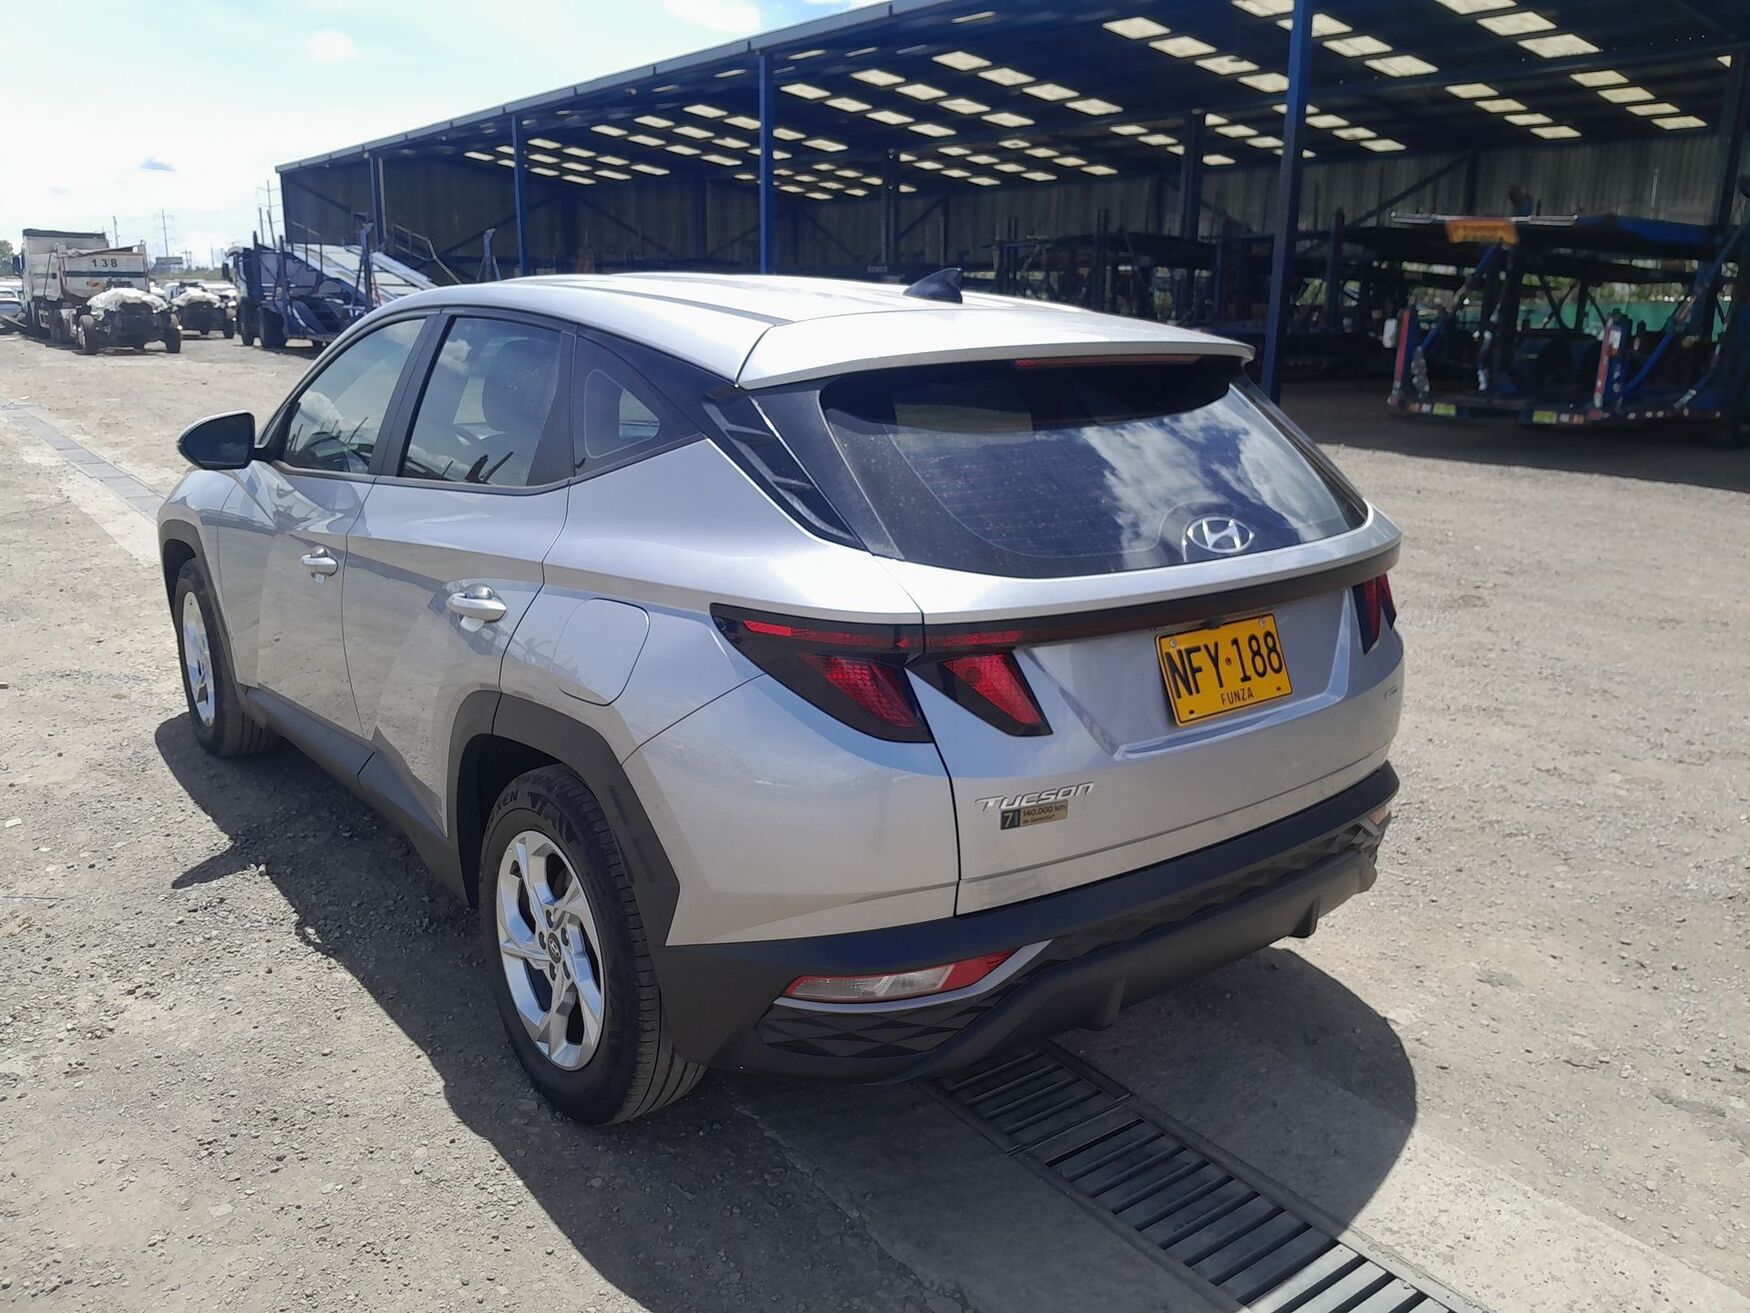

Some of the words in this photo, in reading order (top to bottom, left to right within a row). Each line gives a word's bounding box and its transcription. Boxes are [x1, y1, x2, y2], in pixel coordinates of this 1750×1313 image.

[91, 257, 118, 268] 138
[1164, 641, 1224, 699] NFY
[1231, 630, 1283, 682] 188
[1220, 686, 1254, 706] FUNZA
[974, 780, 1095, 812] TUCSON
[1023, 804, 1053, 817] 140.000
[1054, 803, 1067, 812] km
